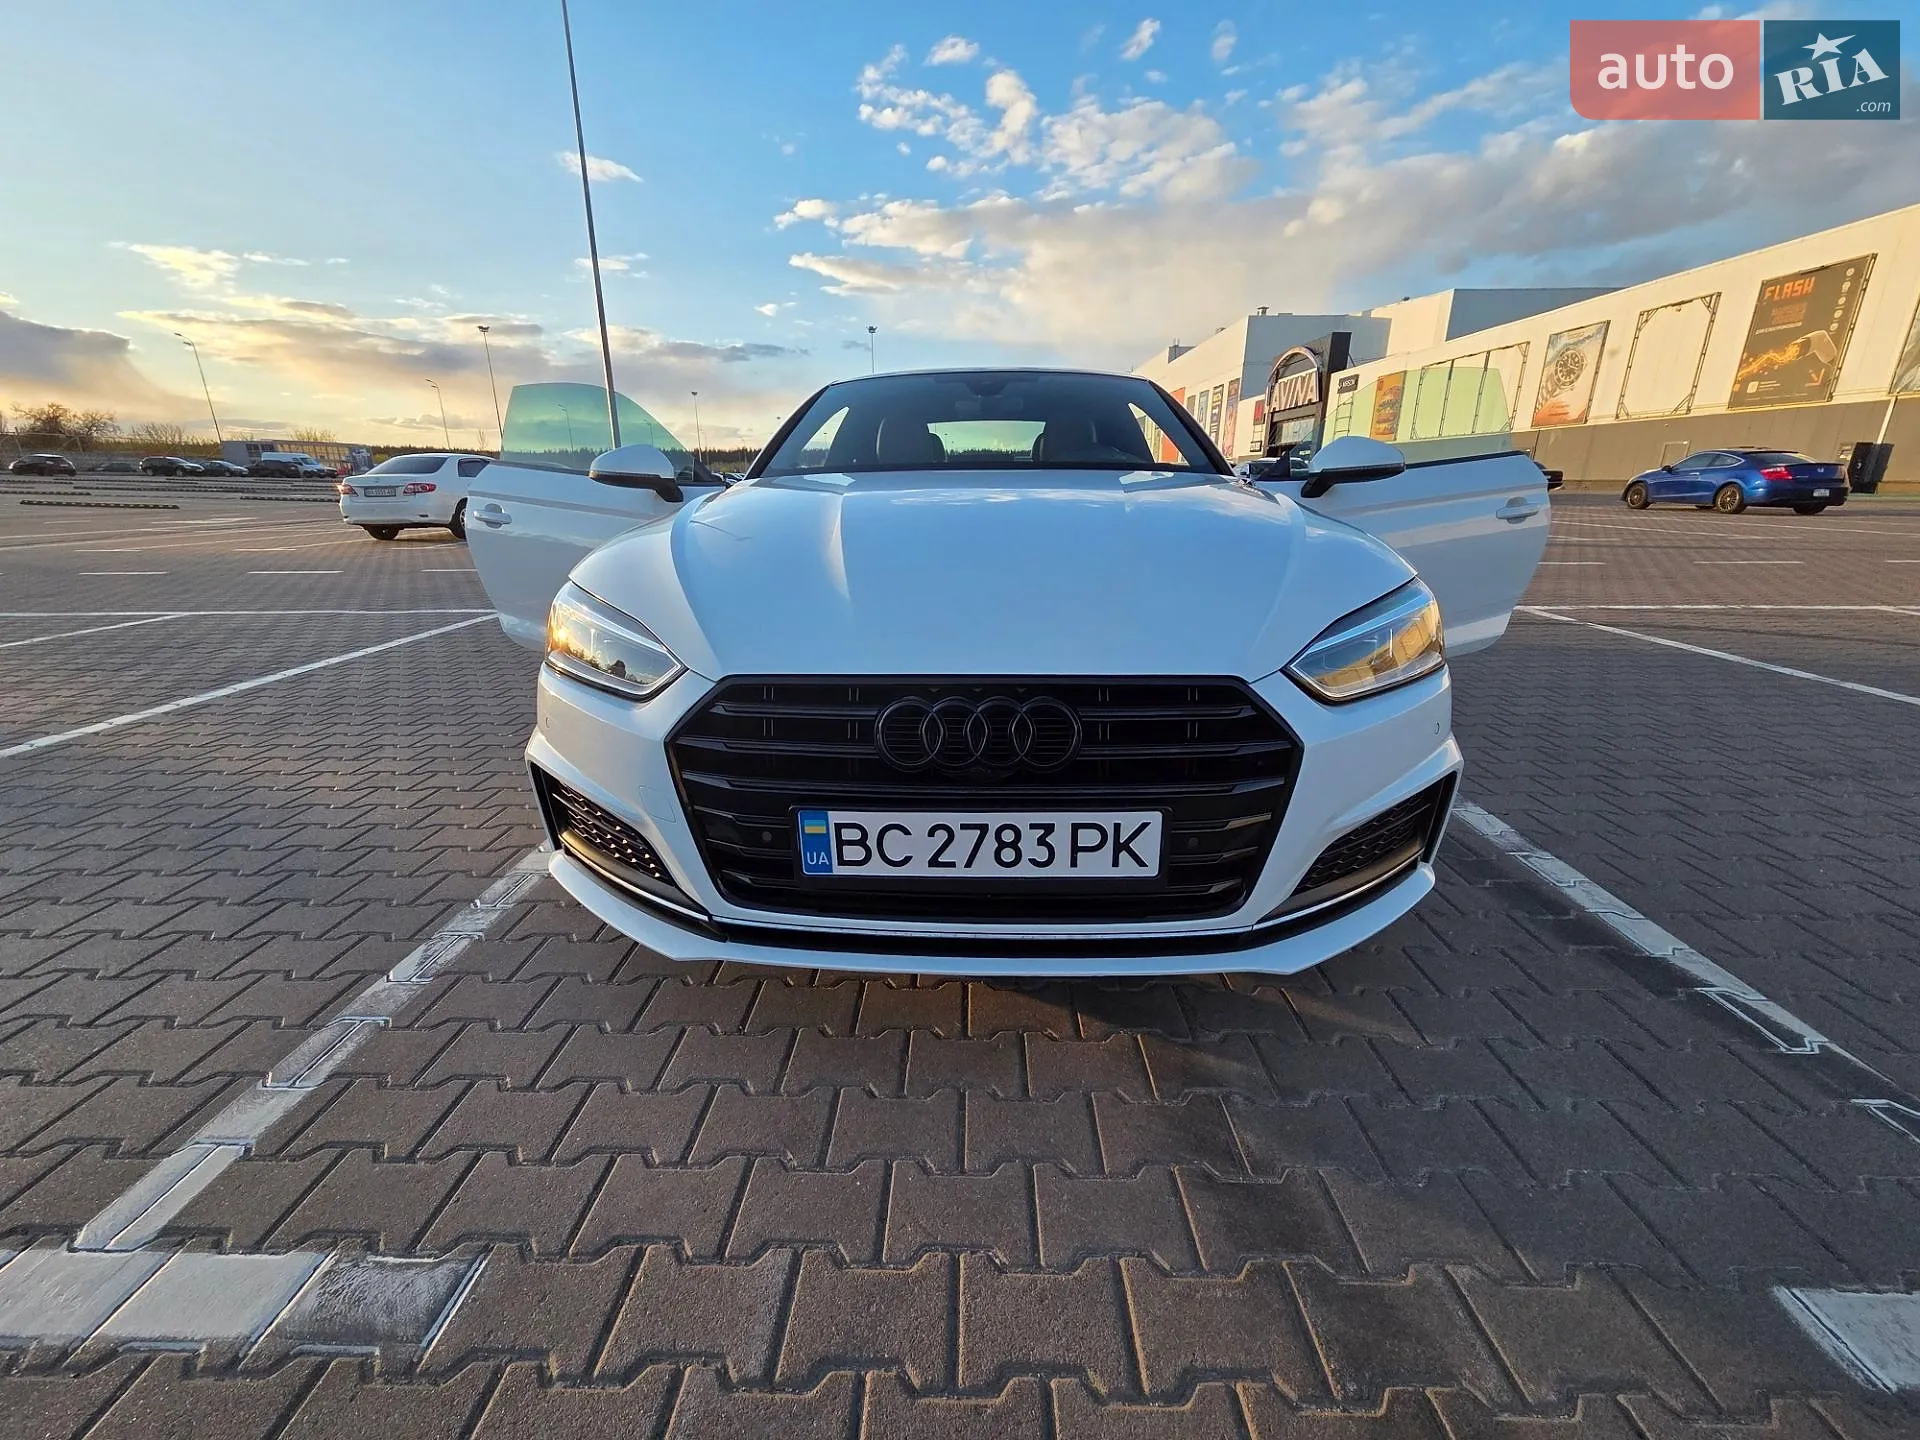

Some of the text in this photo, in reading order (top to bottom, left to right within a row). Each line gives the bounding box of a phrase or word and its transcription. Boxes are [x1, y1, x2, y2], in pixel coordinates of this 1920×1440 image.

[1764, 276, 1815, 300] FLASH
[807, 821, 1153, 869] UA BC 2783 PK
